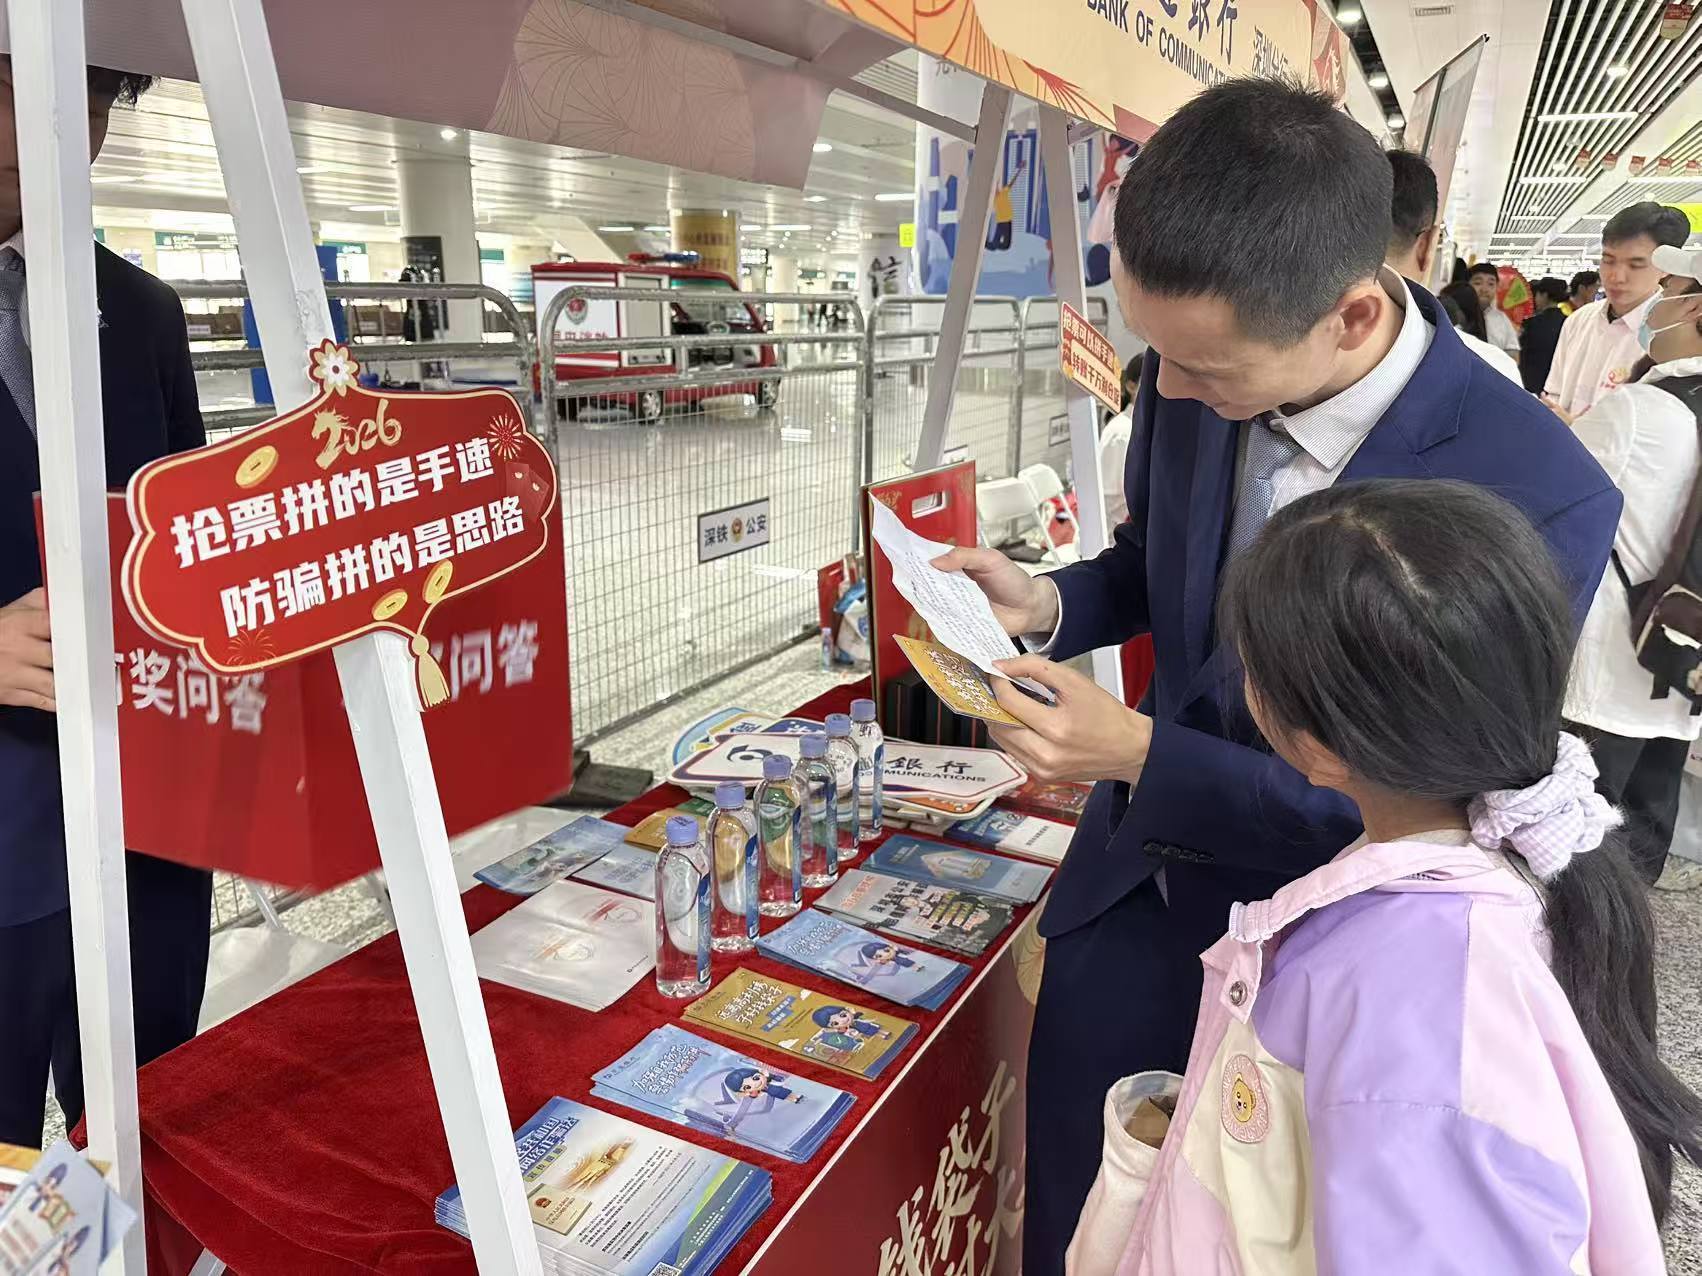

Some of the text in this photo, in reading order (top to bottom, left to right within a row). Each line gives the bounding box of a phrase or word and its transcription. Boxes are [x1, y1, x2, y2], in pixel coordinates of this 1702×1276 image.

[1136, 10, 1154, 47] OF
[312, 398, 402, 470] 2026
[170, 435, 496, 569] 抢票拼的是手速
[219, 494, 525, 638] 防骗拼的是思路
